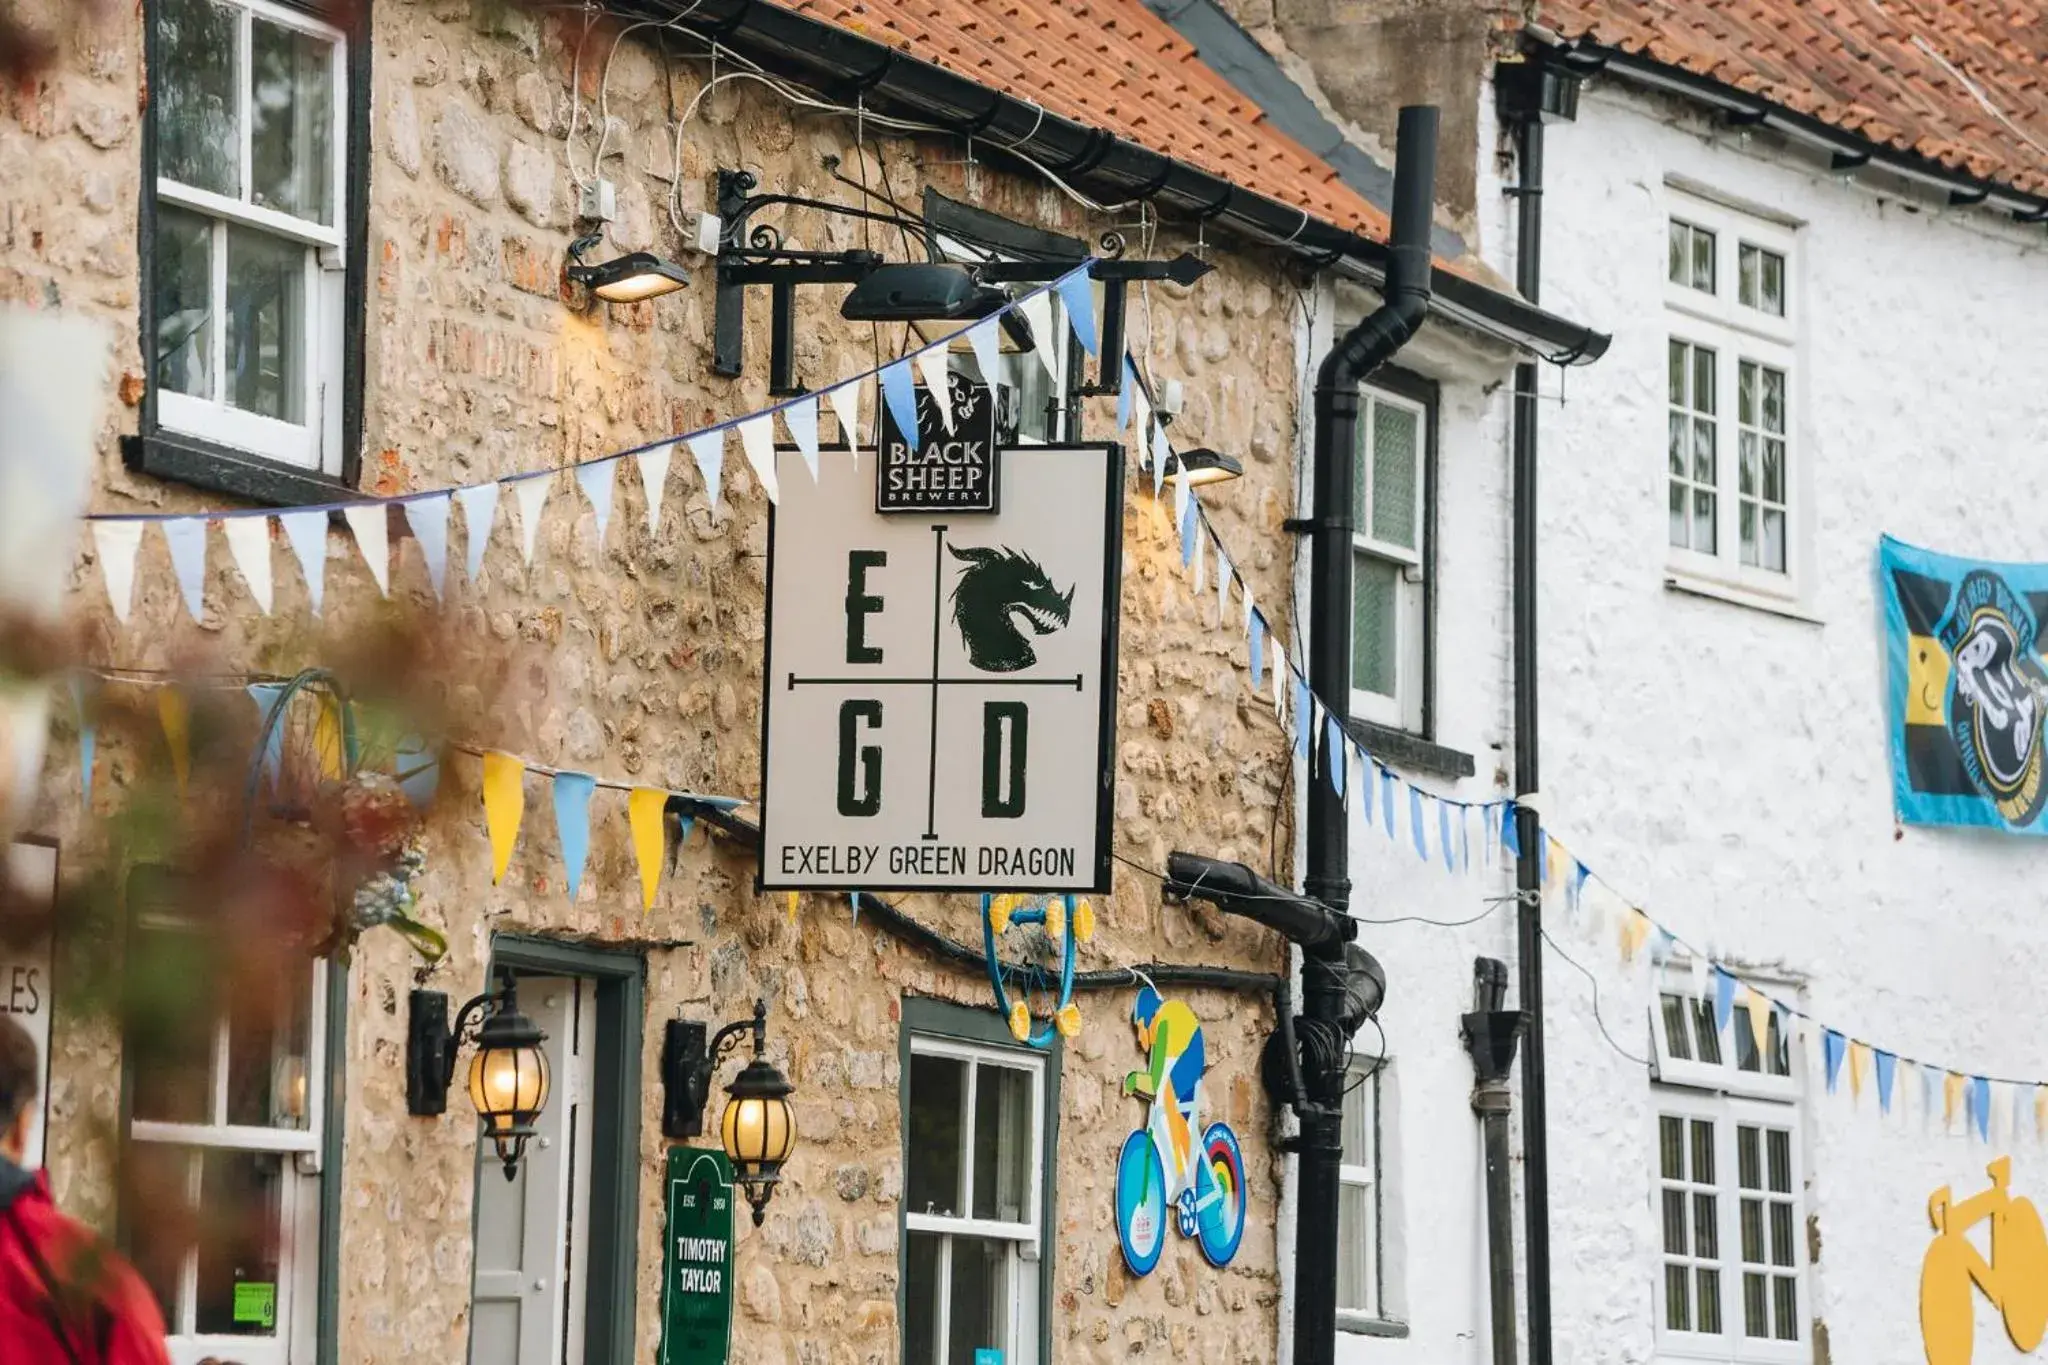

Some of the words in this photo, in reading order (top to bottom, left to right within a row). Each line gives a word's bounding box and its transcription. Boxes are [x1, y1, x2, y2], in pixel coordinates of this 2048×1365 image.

[889, 440, 984, 466] BLACK
[888, 466, 983, 491] SHEEP
[888, 492, 982, 500] BREWERY
[845, 550, 887, 664] E
[837, 699, 883, 817] G
[981, 701, 1029, 818] D
[781, 845, 880, 876] EXELBY
[889, 846, 967, 876] GREEN
[978, 847, 1076, 877] DRAGON
[0, 967, 39, 1014] ES
[677, 1237, 727, 1263] TIMOTHY
[681, 1268, 722, 1293] TAYLOR
